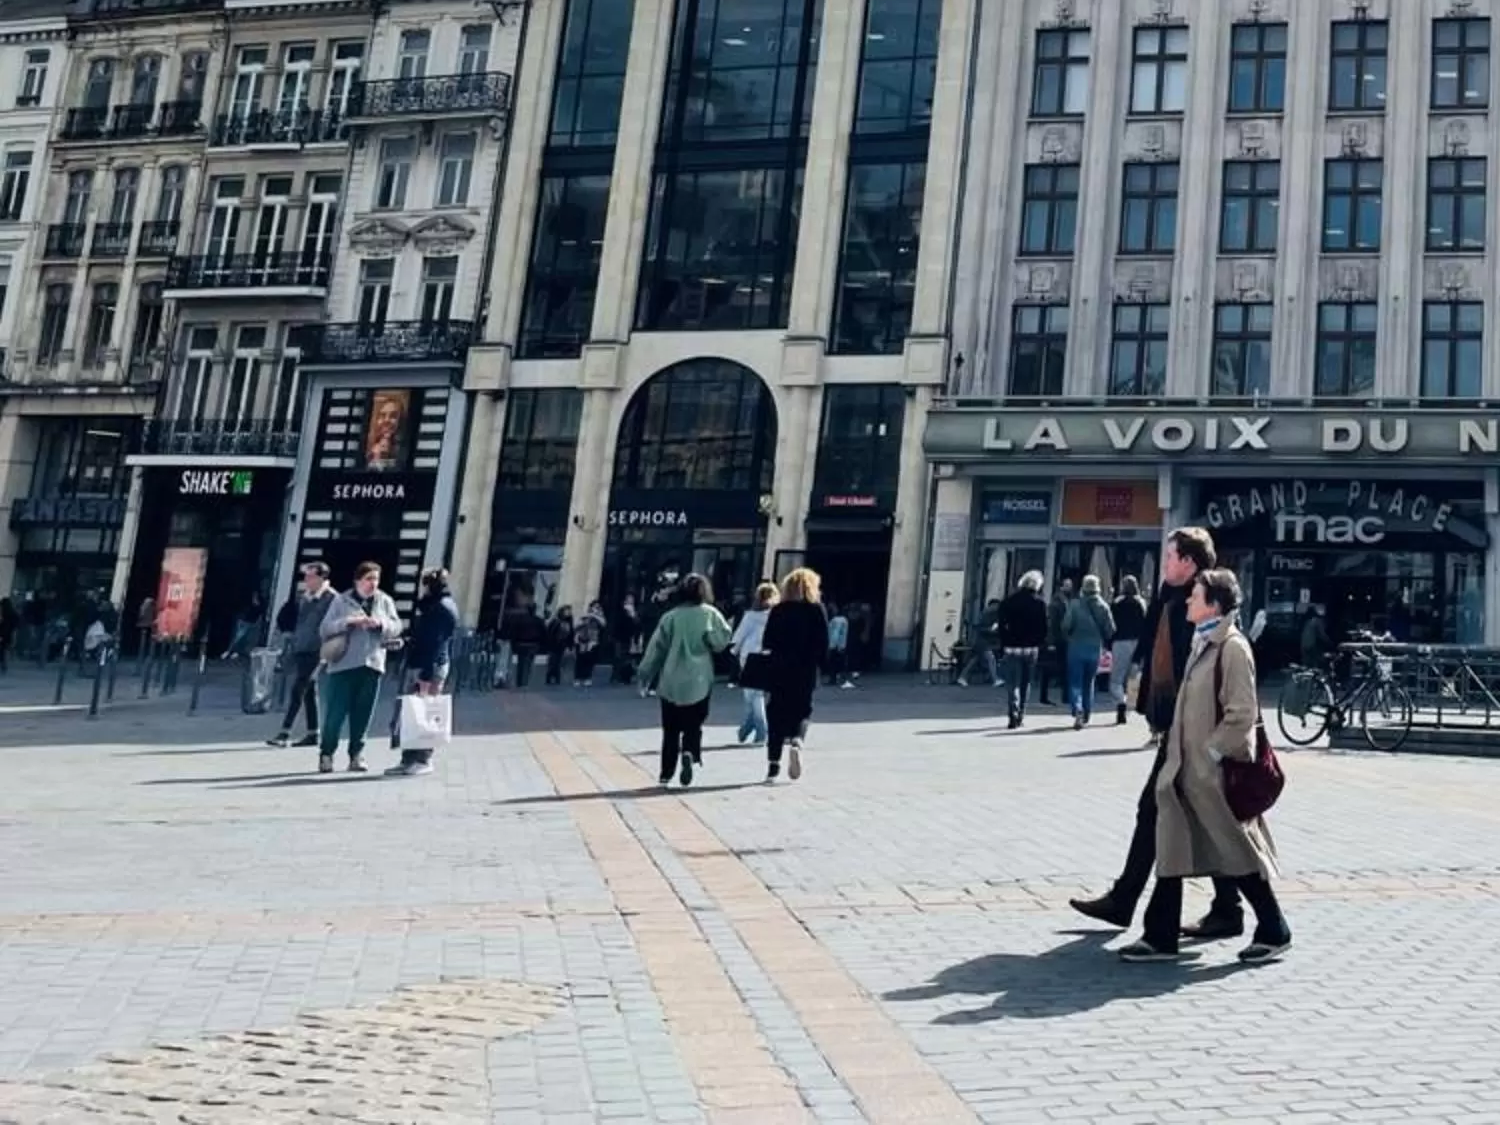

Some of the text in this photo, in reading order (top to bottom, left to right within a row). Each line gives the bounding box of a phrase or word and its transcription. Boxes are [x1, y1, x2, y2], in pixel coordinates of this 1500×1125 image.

[982, 418, 1069, 450] LA
[1102, 416, 1270, 451] VOIX
[1322, 418, 1409, 452] DU
[332, 483, 406, 499] SEPHORA
[1347, 481, 1452, 532] PLACE
[608, 509, 688, 525] SEPHORA
[1274, 510, 1385, 543] fnac
